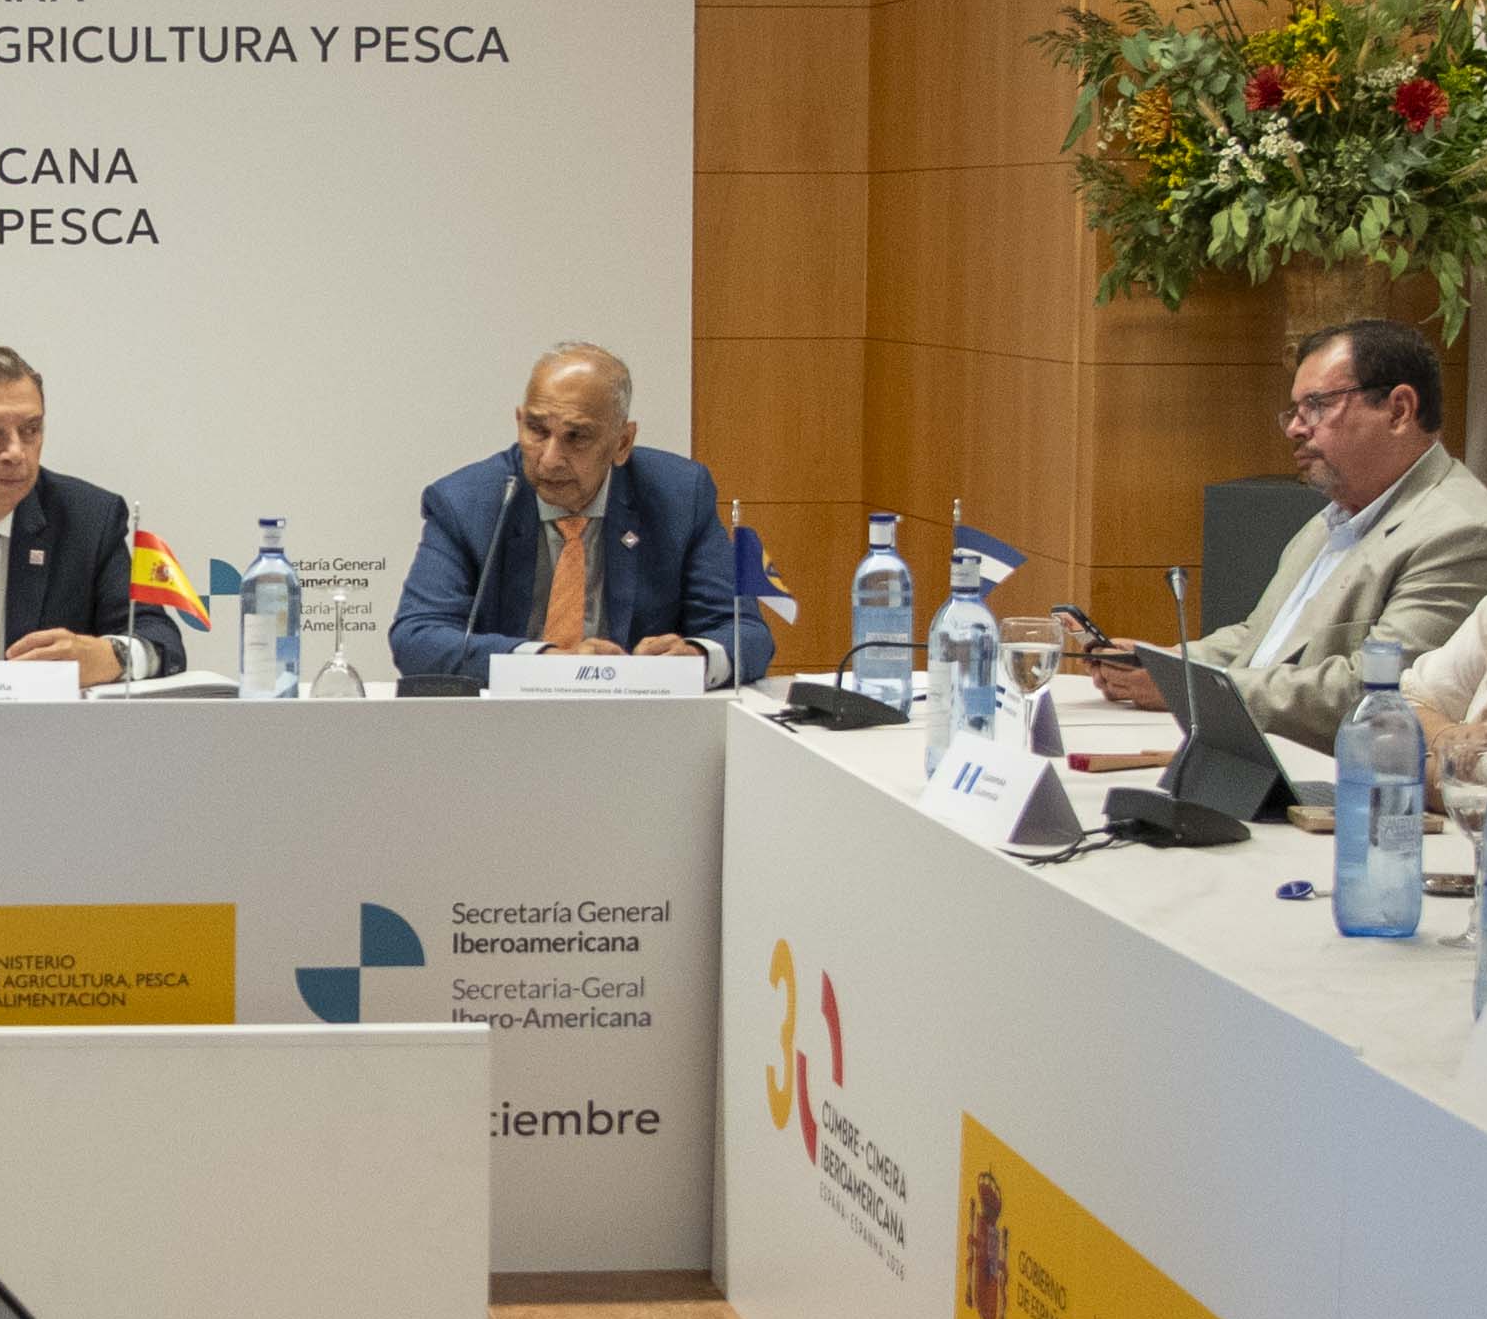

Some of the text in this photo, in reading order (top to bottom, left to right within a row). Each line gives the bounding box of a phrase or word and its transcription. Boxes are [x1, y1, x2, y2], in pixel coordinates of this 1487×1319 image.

[310, 26, 339, 63] Y
[354, 25, 509, 64] PESCA
[292, 557, 386, 571] etaría General
[299, 575, 369, 588] americana
[452, 900, 671, 924] Secretaría General
[452, 931, 640, 954] Iberoamericana
[136, 972, 189, 988] PESCA
[452, 976, 646, 1000] Secretaria-Geral
[491, 1099, 661, 1137] iembre
[822, 1100, 859, 1158] CUMBRE
[865, 1140, 907, 1204] CIMEIRA
[821, 1142, 906, 1250] IBEROAMERICANA
[1018, 1251, 1067, 1311] GOBIERNO
[1016, 1284, 1029, 1314] DE
